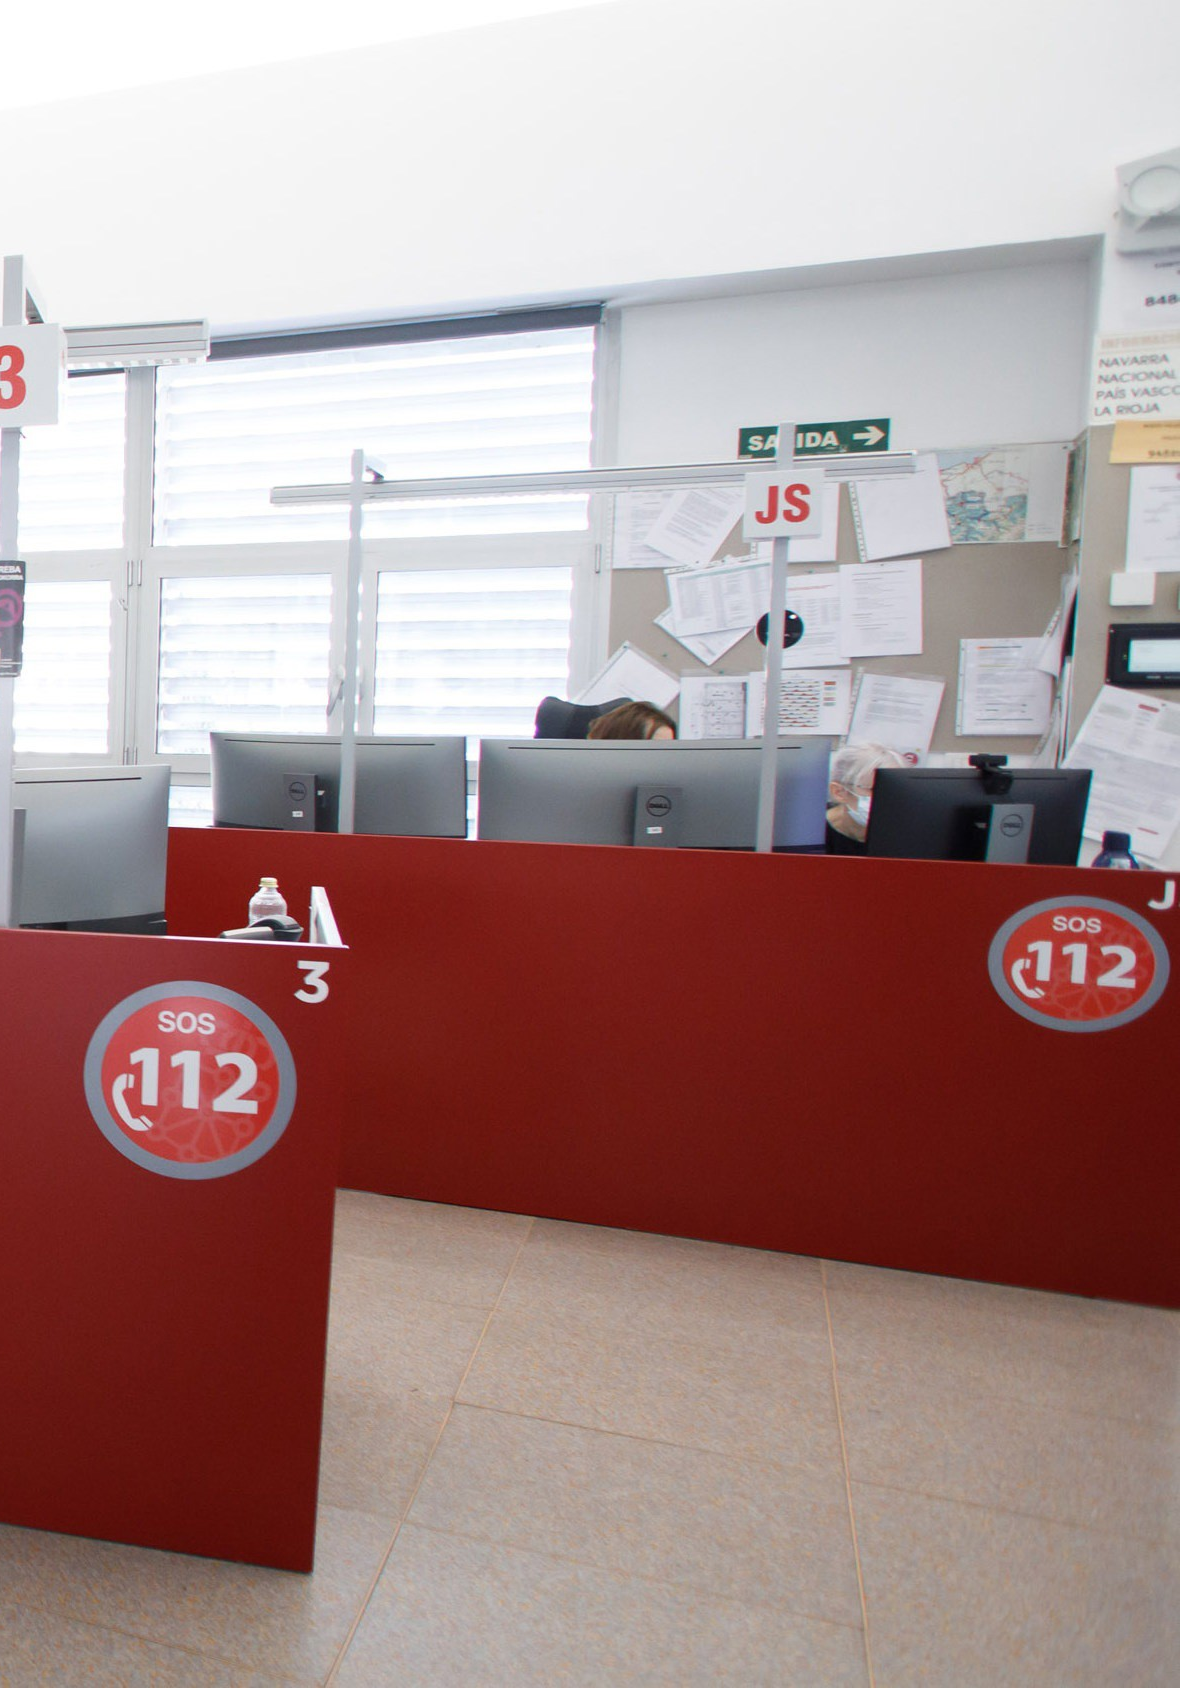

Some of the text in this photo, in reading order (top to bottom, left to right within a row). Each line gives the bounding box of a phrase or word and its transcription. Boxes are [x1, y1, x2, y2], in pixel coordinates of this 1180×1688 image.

[1098, 354, 1169, 368] NAVARRA
[1098, 370, 1176, 384] NACIONAL
[1094, 403, 1160, 417] LA RIOJA
[748, 431, 840, 451] SAIDA
[755, 483, 810, 524] JS
[1147, 879, 1180, 910] J
[1052, 915, 1102, 934] SOS
[1027, 940, 1137, 989] 112
[293, 960, 330, 1003] 3
[157, 1010, 216, 1035] SOS
[129, 1047, 259, 1114] 112
